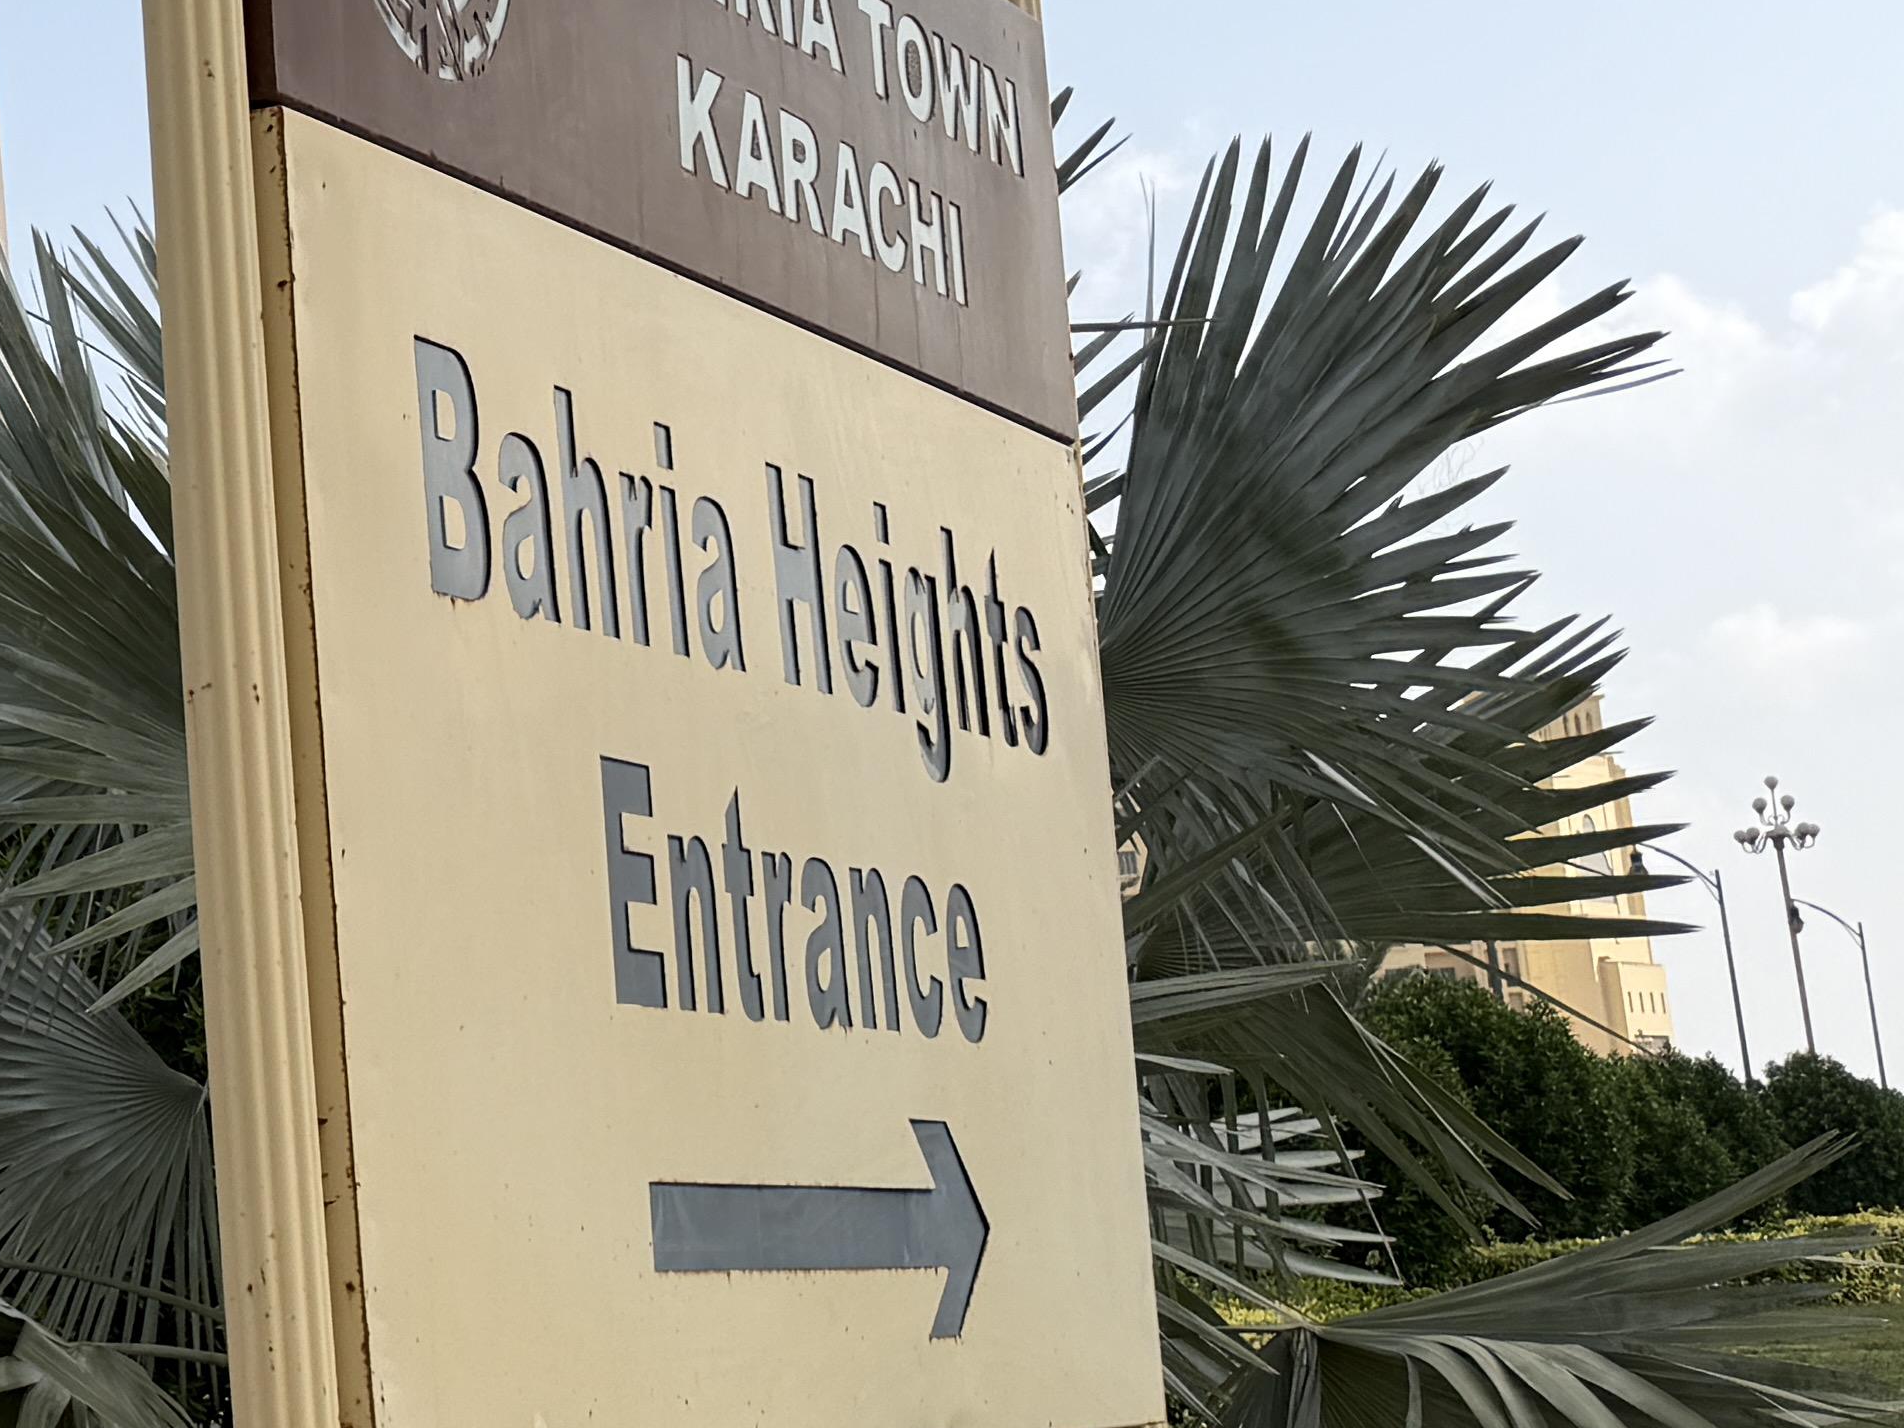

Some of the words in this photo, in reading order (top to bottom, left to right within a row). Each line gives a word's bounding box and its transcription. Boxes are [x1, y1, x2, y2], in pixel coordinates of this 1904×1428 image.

[675, 54, 969, 308] KARACHI
[413, 334, 746, 674] Bahria
[765, 461, 1050, 783] Heights
[600, 754, 989, 1044] Entrance
